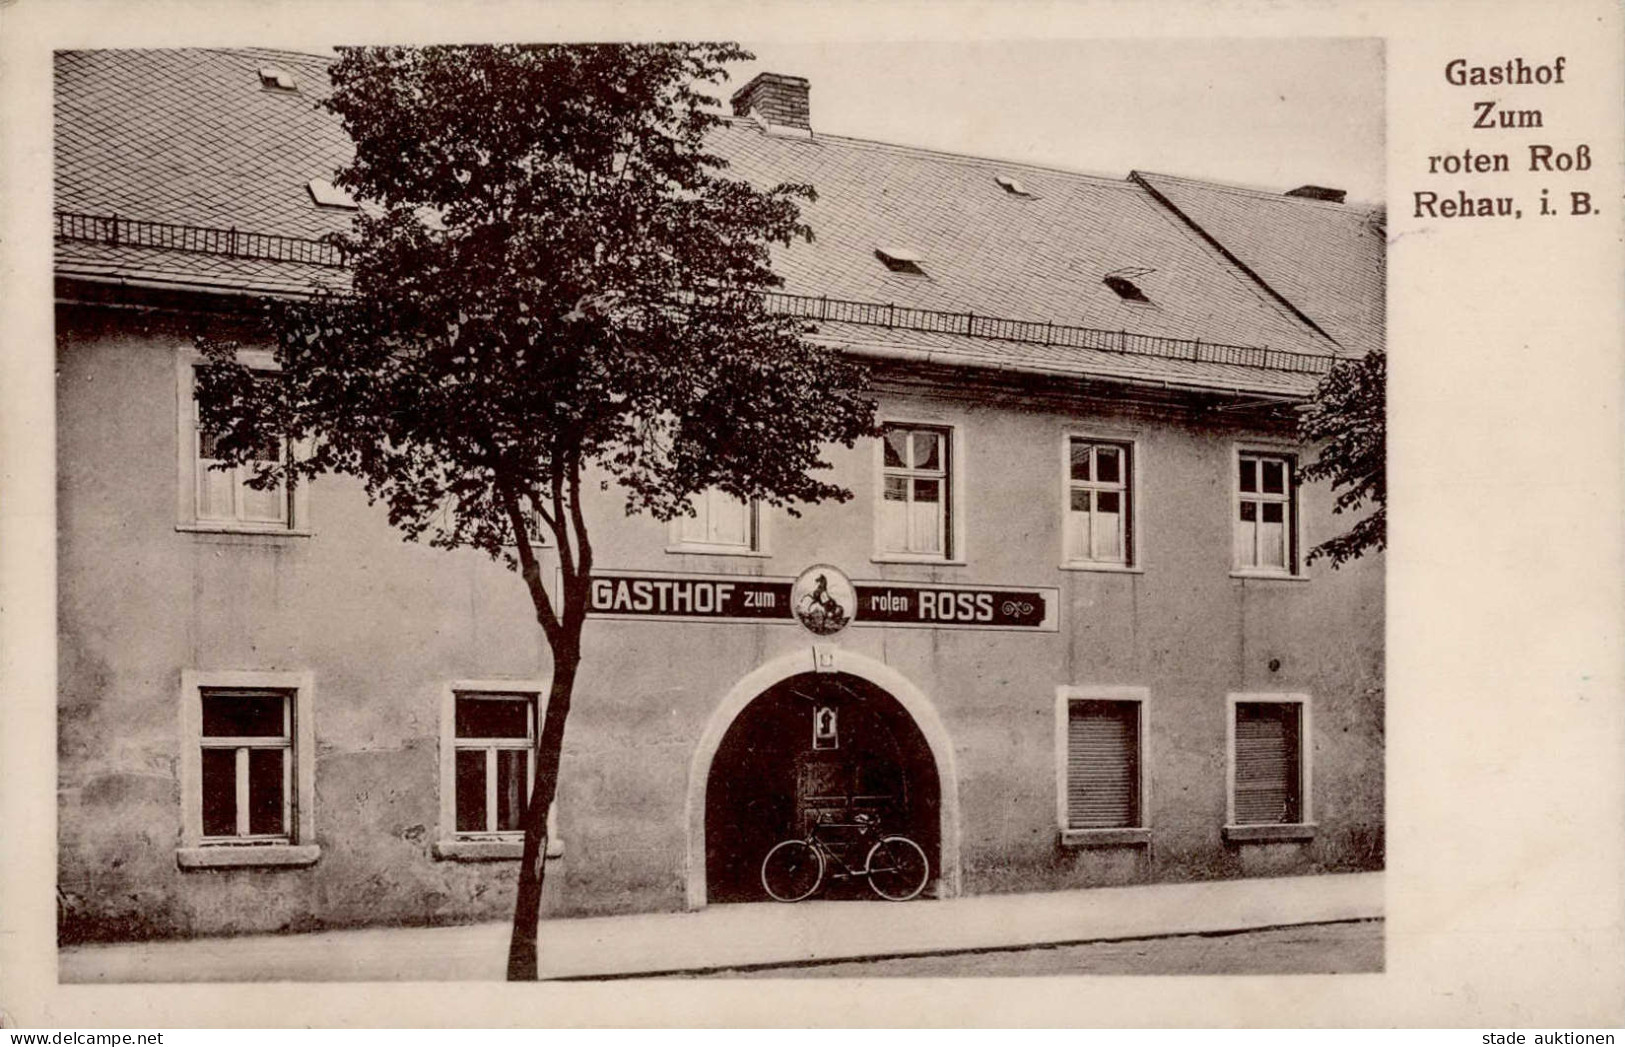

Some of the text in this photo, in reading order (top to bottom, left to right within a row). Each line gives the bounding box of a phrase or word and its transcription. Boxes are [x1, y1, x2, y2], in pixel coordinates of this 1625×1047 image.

[1445, 56, 1566, 86] Gasthof
[1472, 101, 1544, 129] Zum
[1428, 143, 1592, 174] roten Roß
[1413, 188, 1600, 219] Rehau, i. B.
[591, 578, 736, 613] GASTHOF
[743, 590, 776, 608] zum
[918, 591, 994, 621] ROSS
